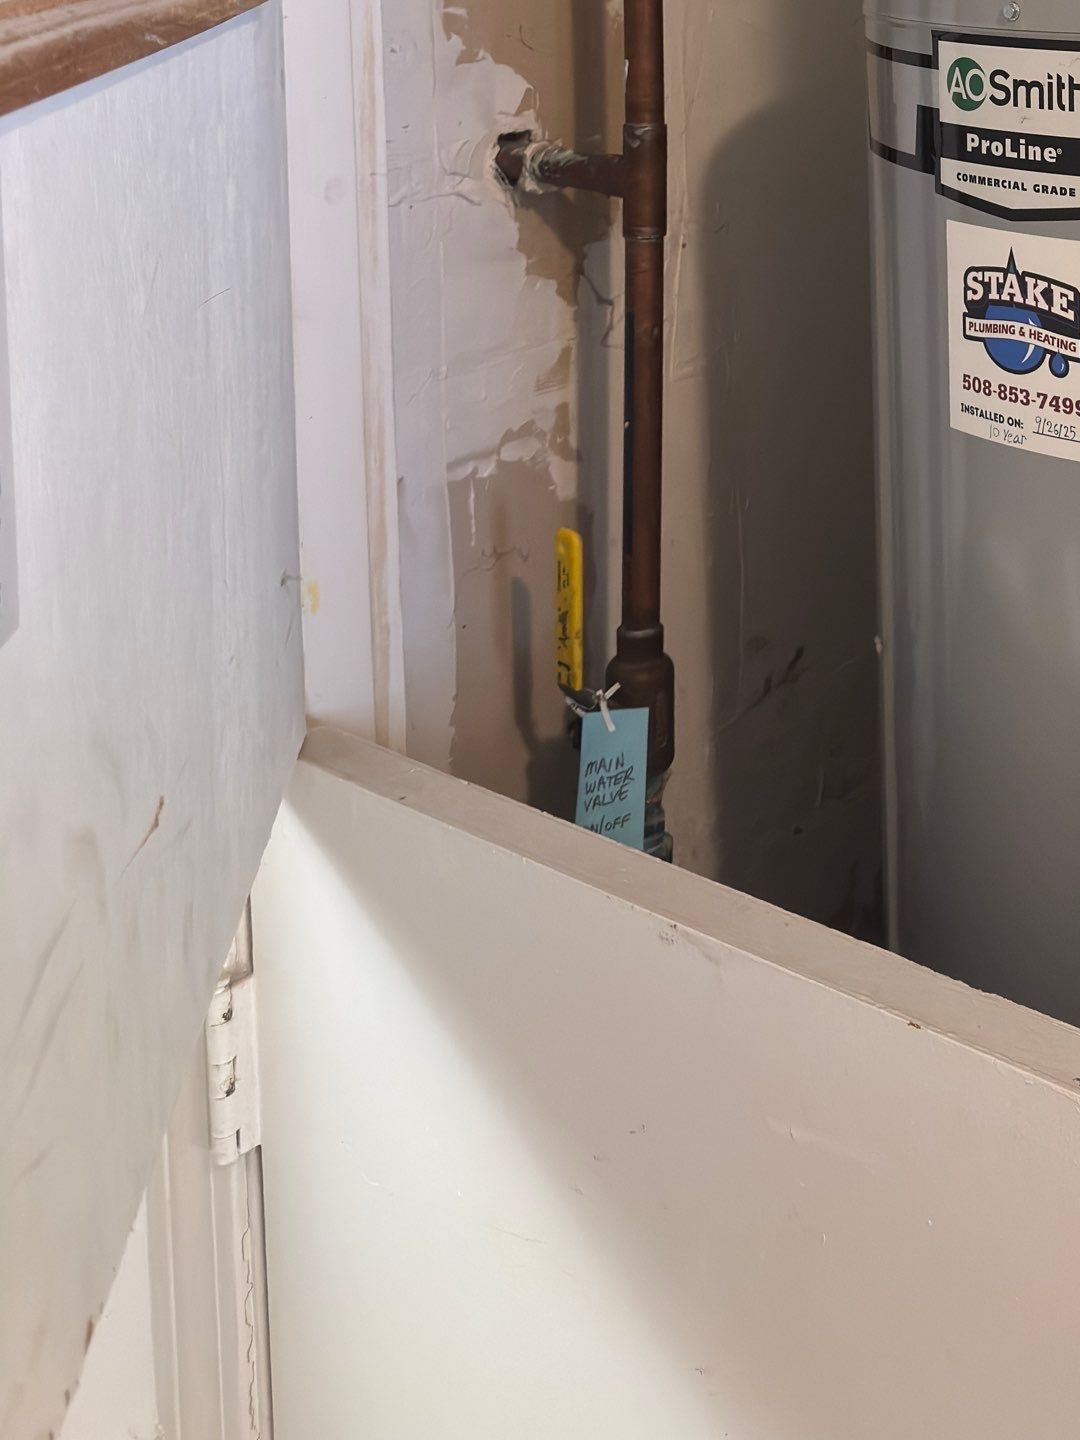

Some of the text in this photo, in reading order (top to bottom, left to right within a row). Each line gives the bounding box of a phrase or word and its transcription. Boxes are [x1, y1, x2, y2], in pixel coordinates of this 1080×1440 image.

[966, 132, 1058, 163] ProLine
[956, 172, 1076, 197] COMMERCIAL GRADE
[966, 271, 1075, 322] STAKE
[968, 321, 1077, 353] PLUMBING & HEATING
[960, 402, 1024, 430] INSTALLED ON:
[1035, 415, 1077, 441] 9/26/25
[585, 752, 625, 777] MAIN
[585, 765, 635, 796] WATER
[584, 782, 630, 813] VALVE
[587, 812, 632, 834] N/OFF
